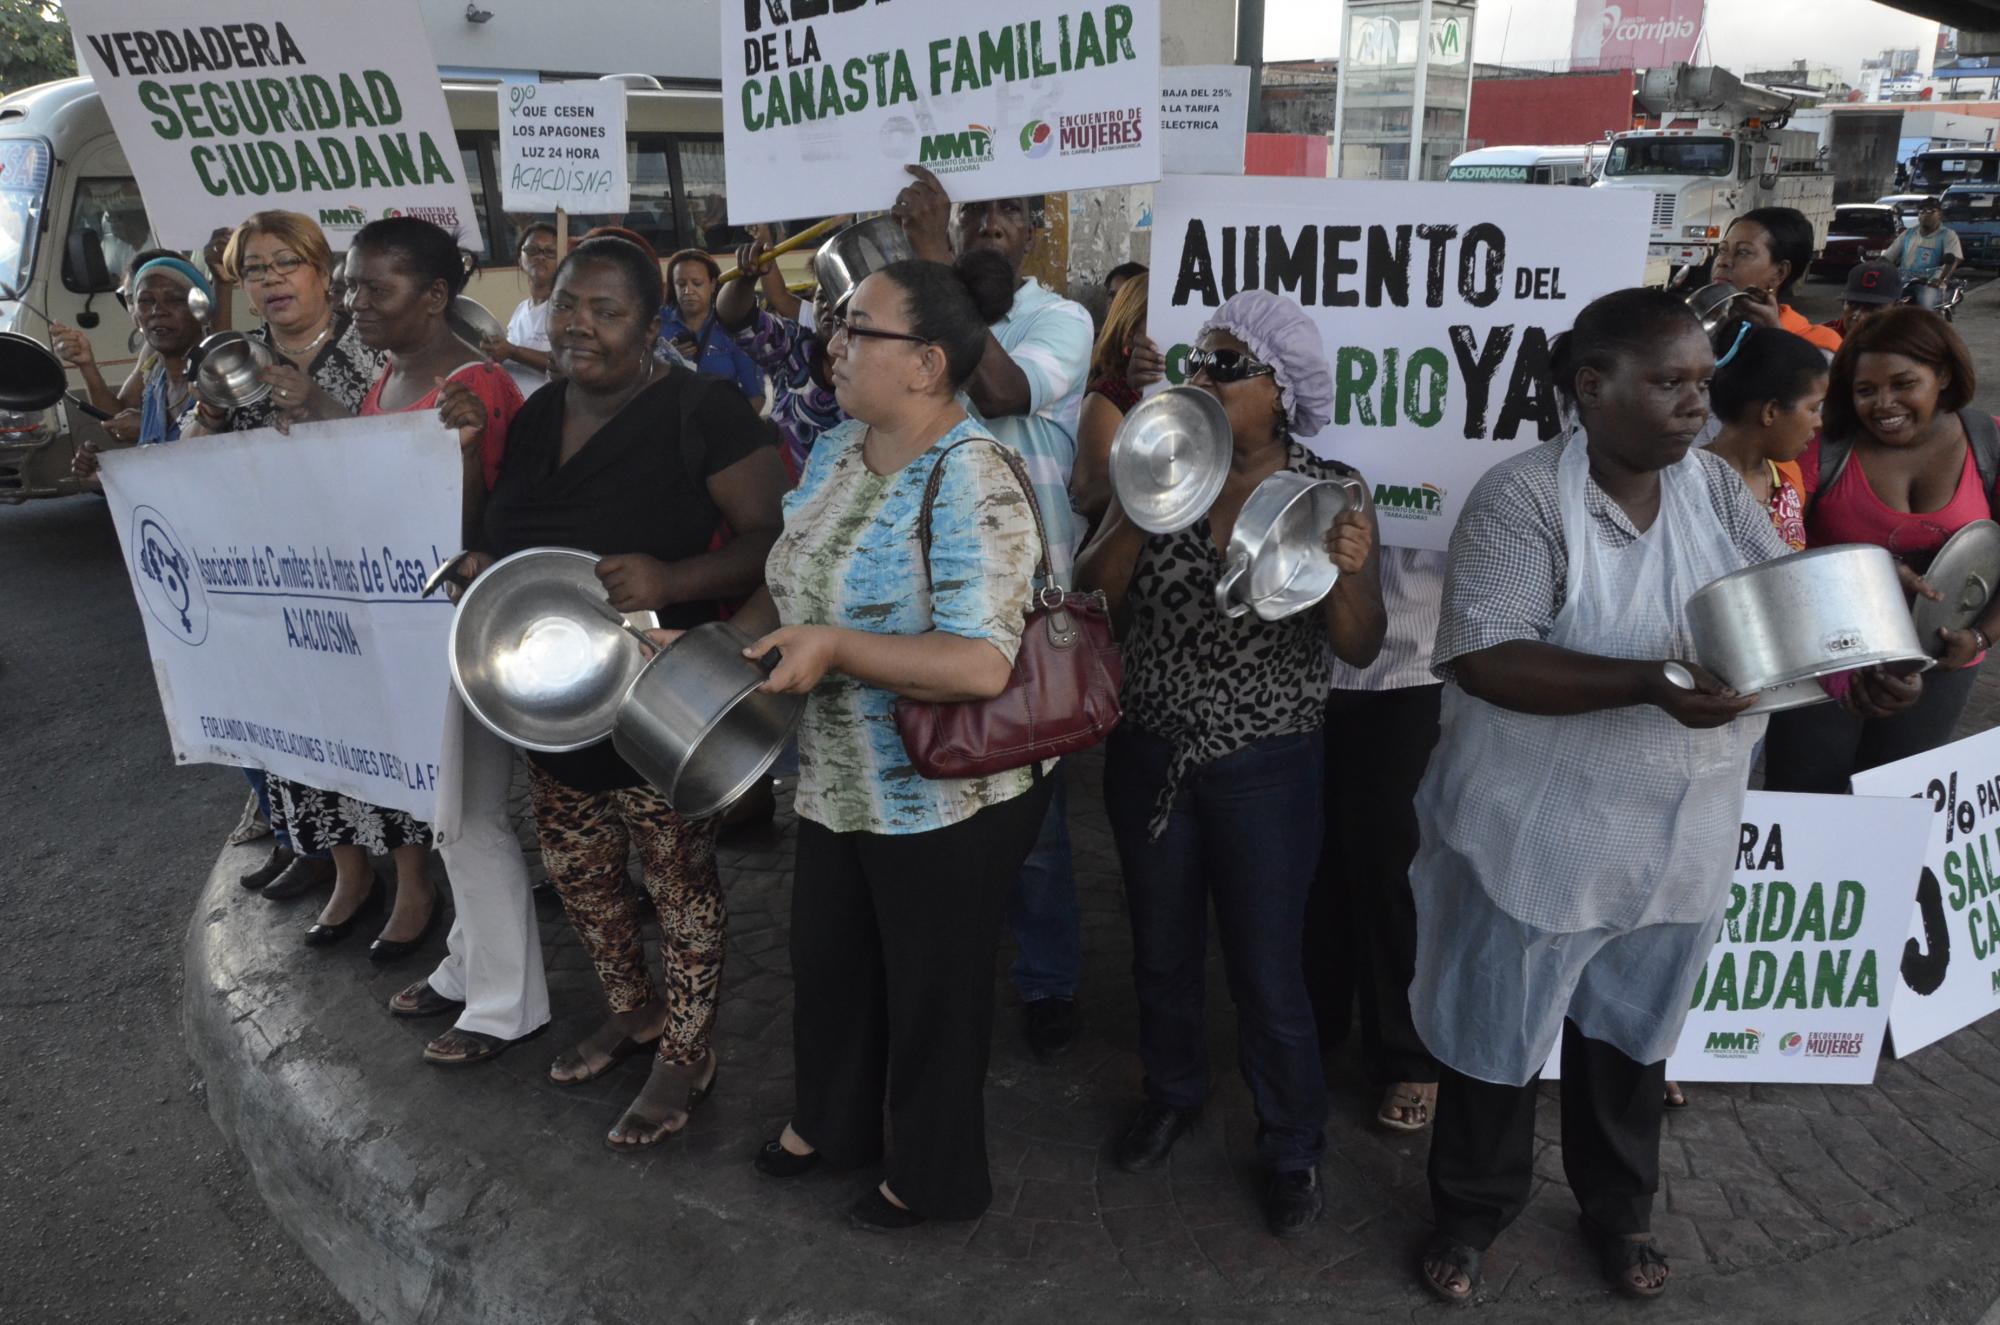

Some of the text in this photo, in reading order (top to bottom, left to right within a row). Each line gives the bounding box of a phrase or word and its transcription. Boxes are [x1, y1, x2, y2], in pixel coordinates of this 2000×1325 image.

[87, 21, 306, 77] VERDADERA
[744, 25, 821, 76] DE LA
[741, 4, 1136, 133] CANASTA FAMILIAR
[138, 70, 402, 140] SEGURIDAD
[1191, 89, 1209, 97] DEL
[1212, 89, 1232, 97] 25%
[522, 106, 595, 118] QUE CESEN
[1059, 107, 1142, 128] ENCUENTRO DE
[1161, 120, 1219, 129] ELECTRICA
[512, 126, 606, 138] LOS APAGONES
[919, 131, 991, 162] MMT
[1060, 119, 1142, 153] MUJERES
[191, 131, 455, 197] CIUDADANA
[521, 147, 600, 160] LUZ 24 HORA
[968, 155, 995, 164] MUJERES
[1451, 167, 1528, 180] ASOTRAYASA
[1171, 218, 1567, 308] AUMENTO DEL
[1326, 323, 1564, 442] RIO YA
[359, 546, 384, 593] de
[382, 546, 428, 593] Casa
[404, 762, 427, 791] LA
[427, 763, 440, 791] F
[1735, 822, 1784, 871] RA
[1943, 826, 2000, 911] SAL
[1714, 880, 1866, 943] RIDAD
[1805, 1039, 1862, 1056] MUJERES
[1808, 1031, 1852, 1041] ENCUENTRO
